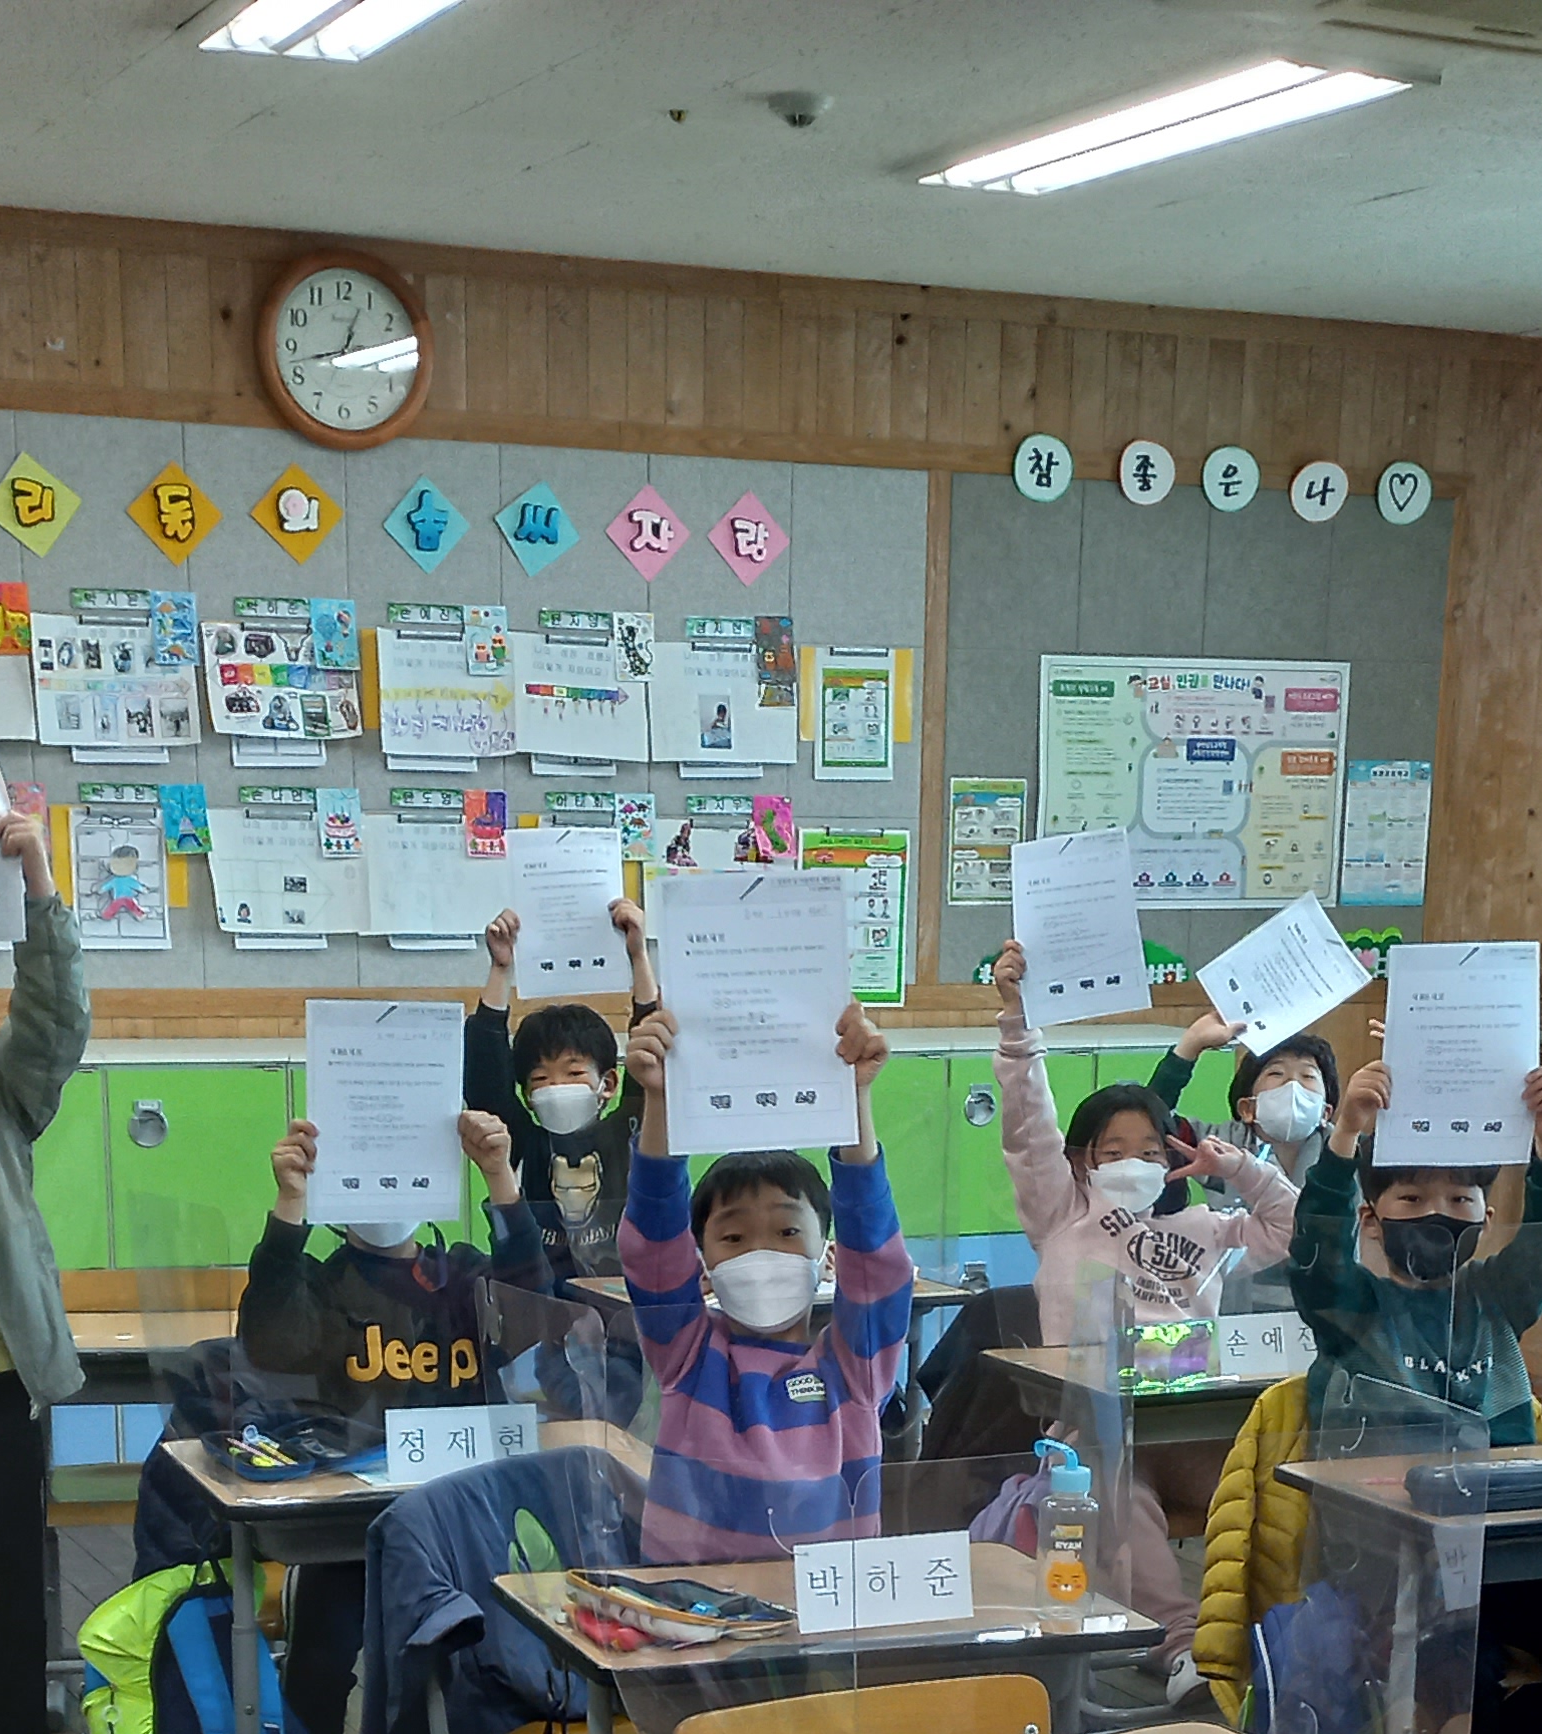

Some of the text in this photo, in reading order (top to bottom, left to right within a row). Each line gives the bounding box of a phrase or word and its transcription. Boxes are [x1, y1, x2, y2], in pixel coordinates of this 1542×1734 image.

[310, 286, 323, 306] 11
[335, 281, 352, 301] 12
[367, 292, 373, 311] 1
[290, 308, 307, 328] 10
[384, 313, 394, 331] 2
[285, 338, 297, 355] 9
[292, 366, 305, 385] 8
[313, 391, 323, 411] 7
[367, 396, 378, 413] 5
[338, 405, 350, 420] 6
[1027, 447, 1336, 506] 참 좋 은 나
[11, 475, 55, 528] 리
[276, 486, 320, 534] 의
[406, 488, 448, 552] 솜
[513, 502, 559, 545] 씨
[628, 509, 675, 553] 자
[730, 516, 770, 563] 랑
[345, 1324, 479, 1389] Jeep
[398, 1424, 524, 1464] 정제현
[806, 1557, 959, 1607] 박하준
